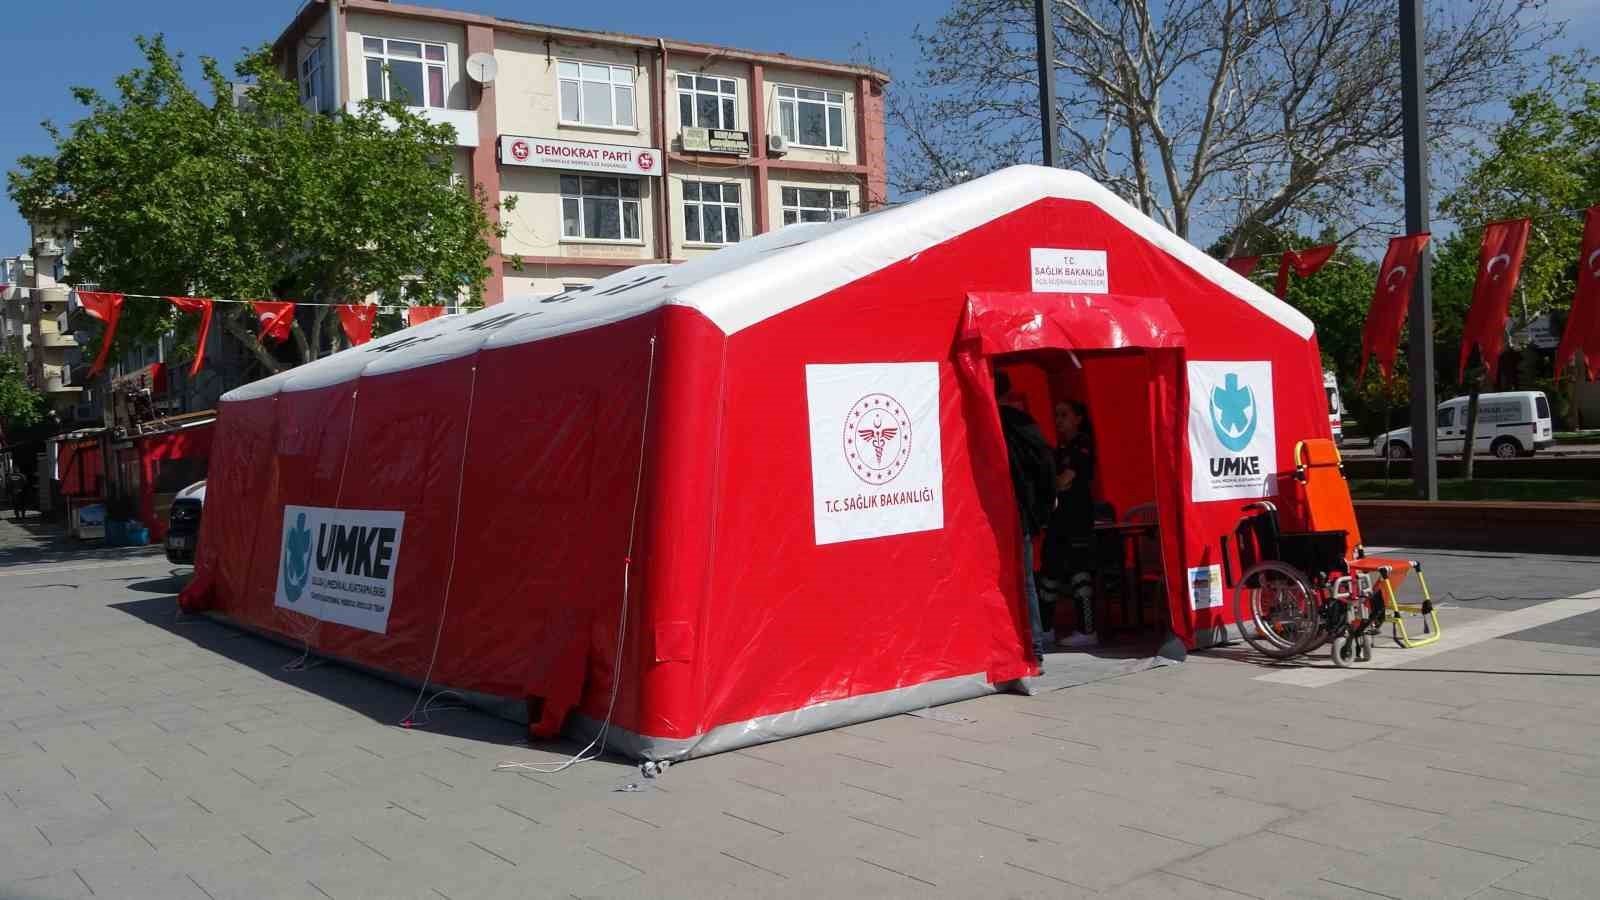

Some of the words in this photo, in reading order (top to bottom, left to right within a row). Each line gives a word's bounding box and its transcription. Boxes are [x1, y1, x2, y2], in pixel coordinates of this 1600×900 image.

[536, 145, 599, 159] DEMOKRAT
[602, 150, 632, 162] PARTİ
[1034, 265, 1063, 276] SAĞLIK
[1064, 266, 1105, 277] BAKANLIĞI
[1209, 456, 1260, 477] UMKE
[825, 500, 842, 512] T.C.
[844, 494, 878, 512] SAĞLIK
[880, 487, 934, 507] BAKANLIĞI
[316, 522, 397, 580] UMKE
